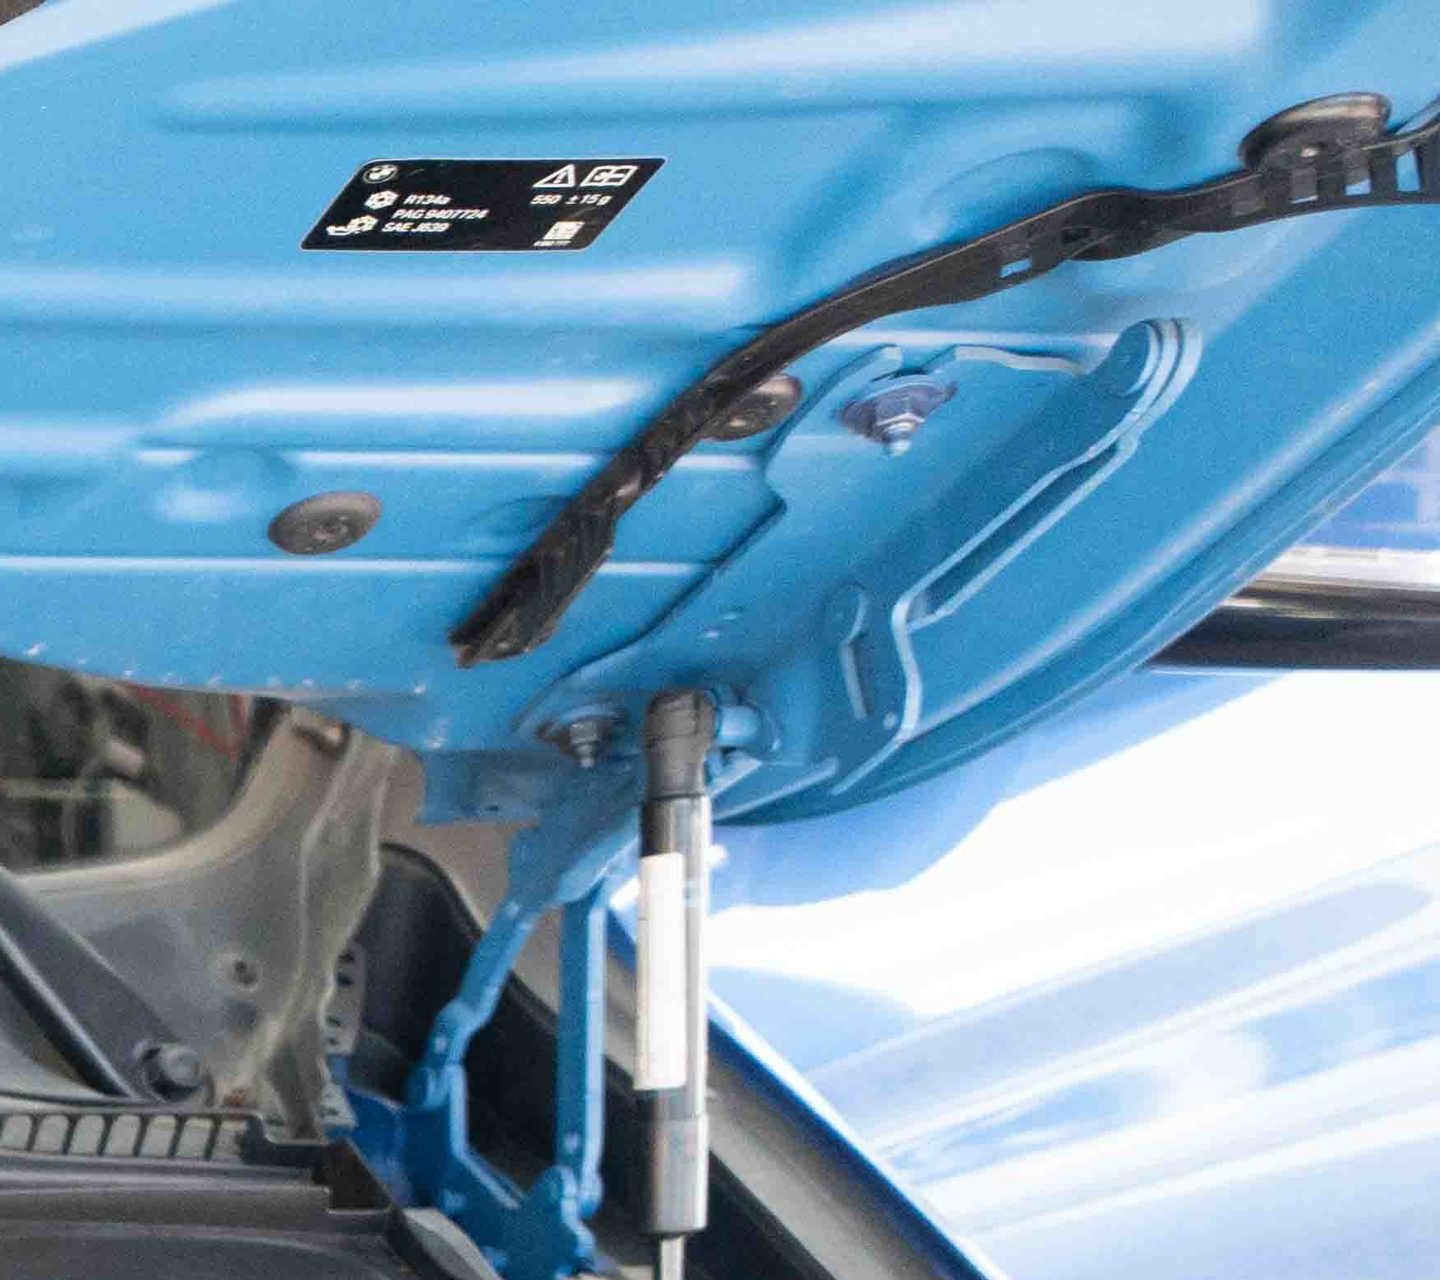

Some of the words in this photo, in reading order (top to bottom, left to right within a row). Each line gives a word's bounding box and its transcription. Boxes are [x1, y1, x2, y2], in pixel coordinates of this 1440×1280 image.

[403, 194, 451, 205] R134a
[391, 208, 425, 219] PAG
[381, 222, 416, 232] SAE
